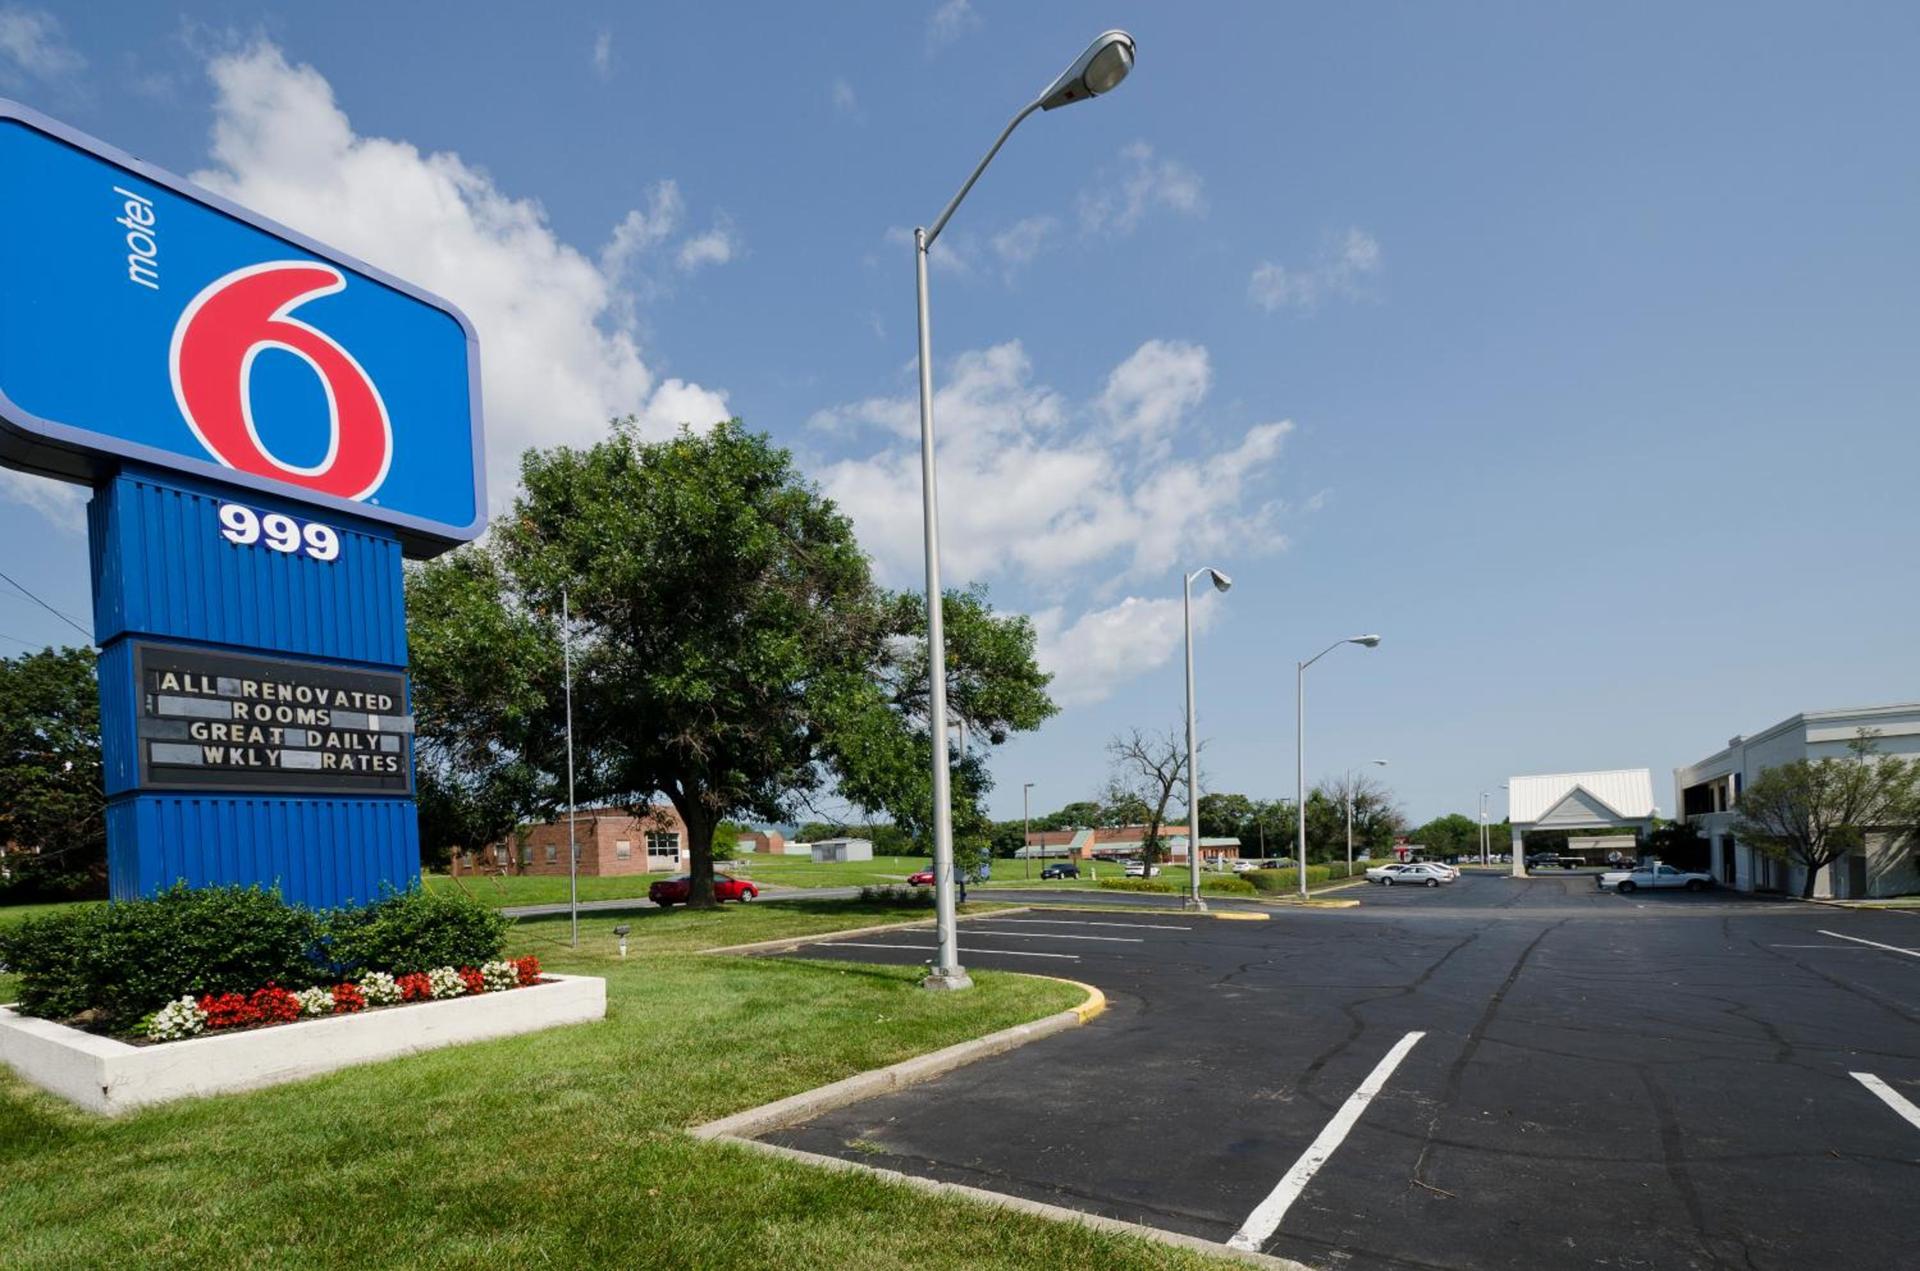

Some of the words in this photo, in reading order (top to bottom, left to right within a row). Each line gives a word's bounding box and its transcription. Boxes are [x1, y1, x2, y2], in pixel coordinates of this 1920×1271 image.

[113, 186, 159, 289] motel
[169, 260, 393, 503] 6
[219, 504, 340, 561] 999
[161, 672, 216, 694] ALL
[242, 680, 393, 711] RENOVATED
[233, 702, 330, 726] ROOMS
[190, 722, 283, 745] GREAT
[307, 730, 379, 750] DAILY
[203, 746, 280, 767] WKLY
[322, 752, 398, 772] RATES
